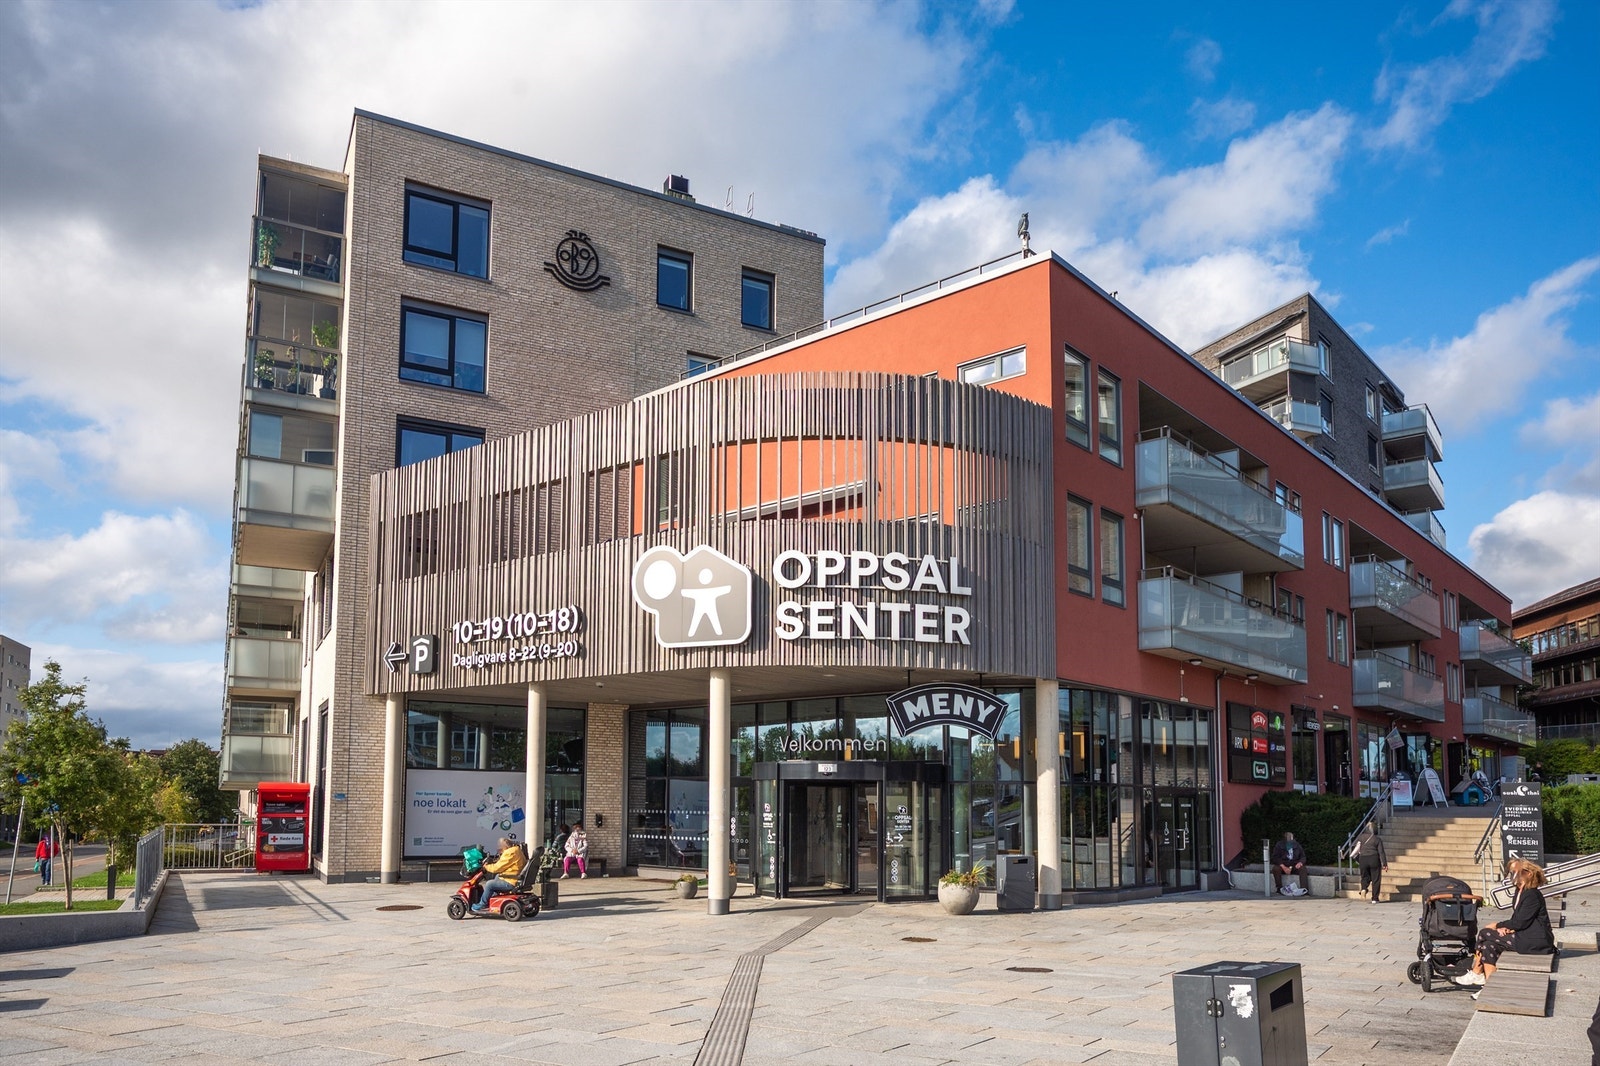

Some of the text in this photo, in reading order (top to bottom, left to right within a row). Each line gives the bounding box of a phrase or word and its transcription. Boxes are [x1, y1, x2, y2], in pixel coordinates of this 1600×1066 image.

[773, 549, 972, 596] OPPSAL
[775, 600, 971, 645] SENTER
[415, 645, 428, 671] P
[452, 652, 507, 670] Dagligvare
[902, 693, 996, 723] MENY
[779, 735, 887, 752] Velkommen
[413, 798, 467, 808] noe lokalt
